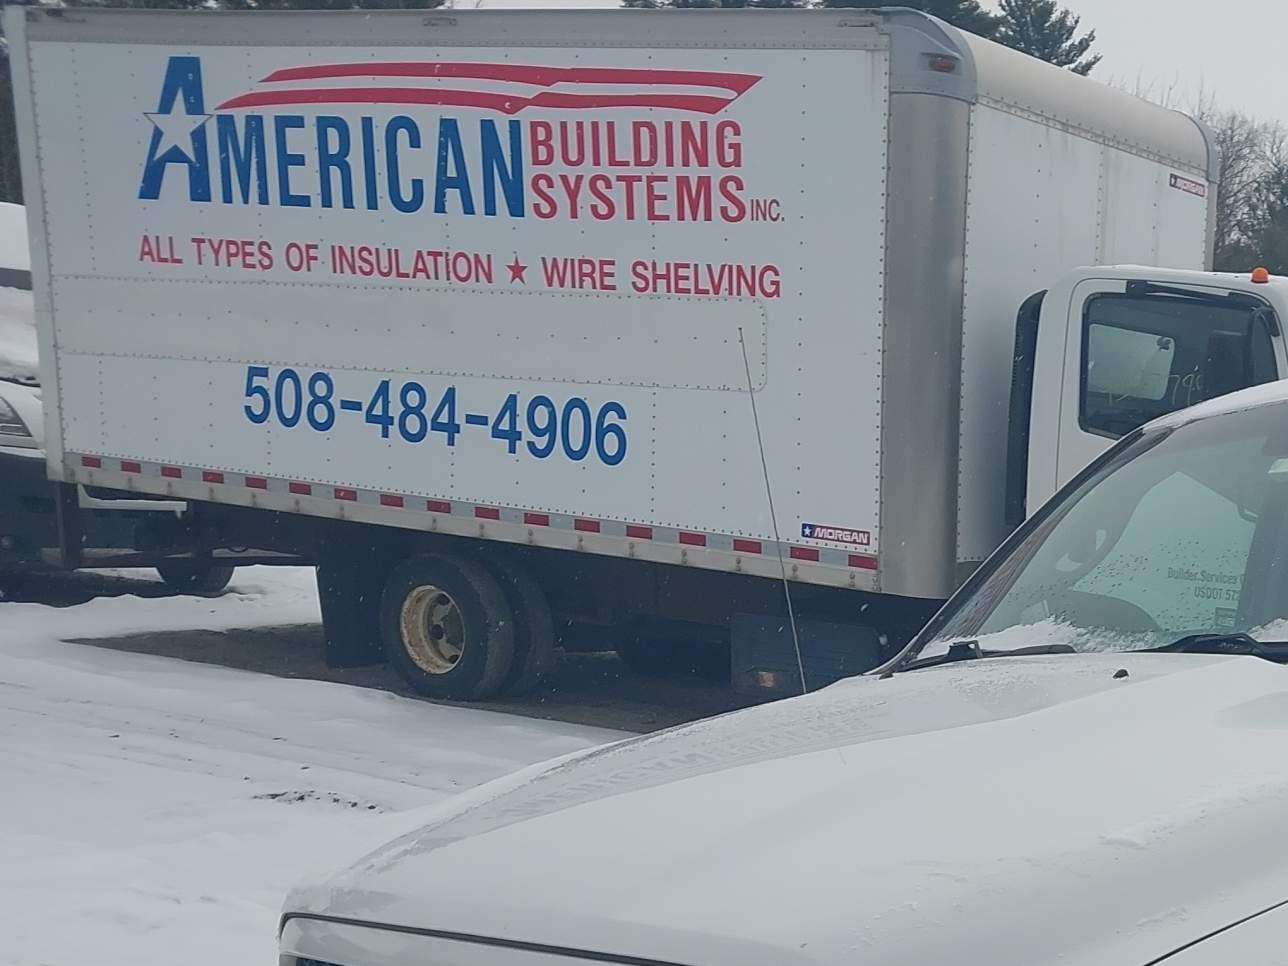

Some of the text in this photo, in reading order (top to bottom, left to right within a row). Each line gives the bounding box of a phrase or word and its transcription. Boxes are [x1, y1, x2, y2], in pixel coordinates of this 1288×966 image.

[138, 56, 526, 218] AMERICAN
[529, 119, 742, 168] BUILDING
[531, 173, 785, 223] SYSTEMS INC.
[139, 234, 781, 298] ALL TYPES OF INSULATION WIRE SHELVING
[243, 365, 628, 467] 508-484-4906
[813, 527, 869, 544] MORGAN
[1193, 586, 1223, 601] USDOT
